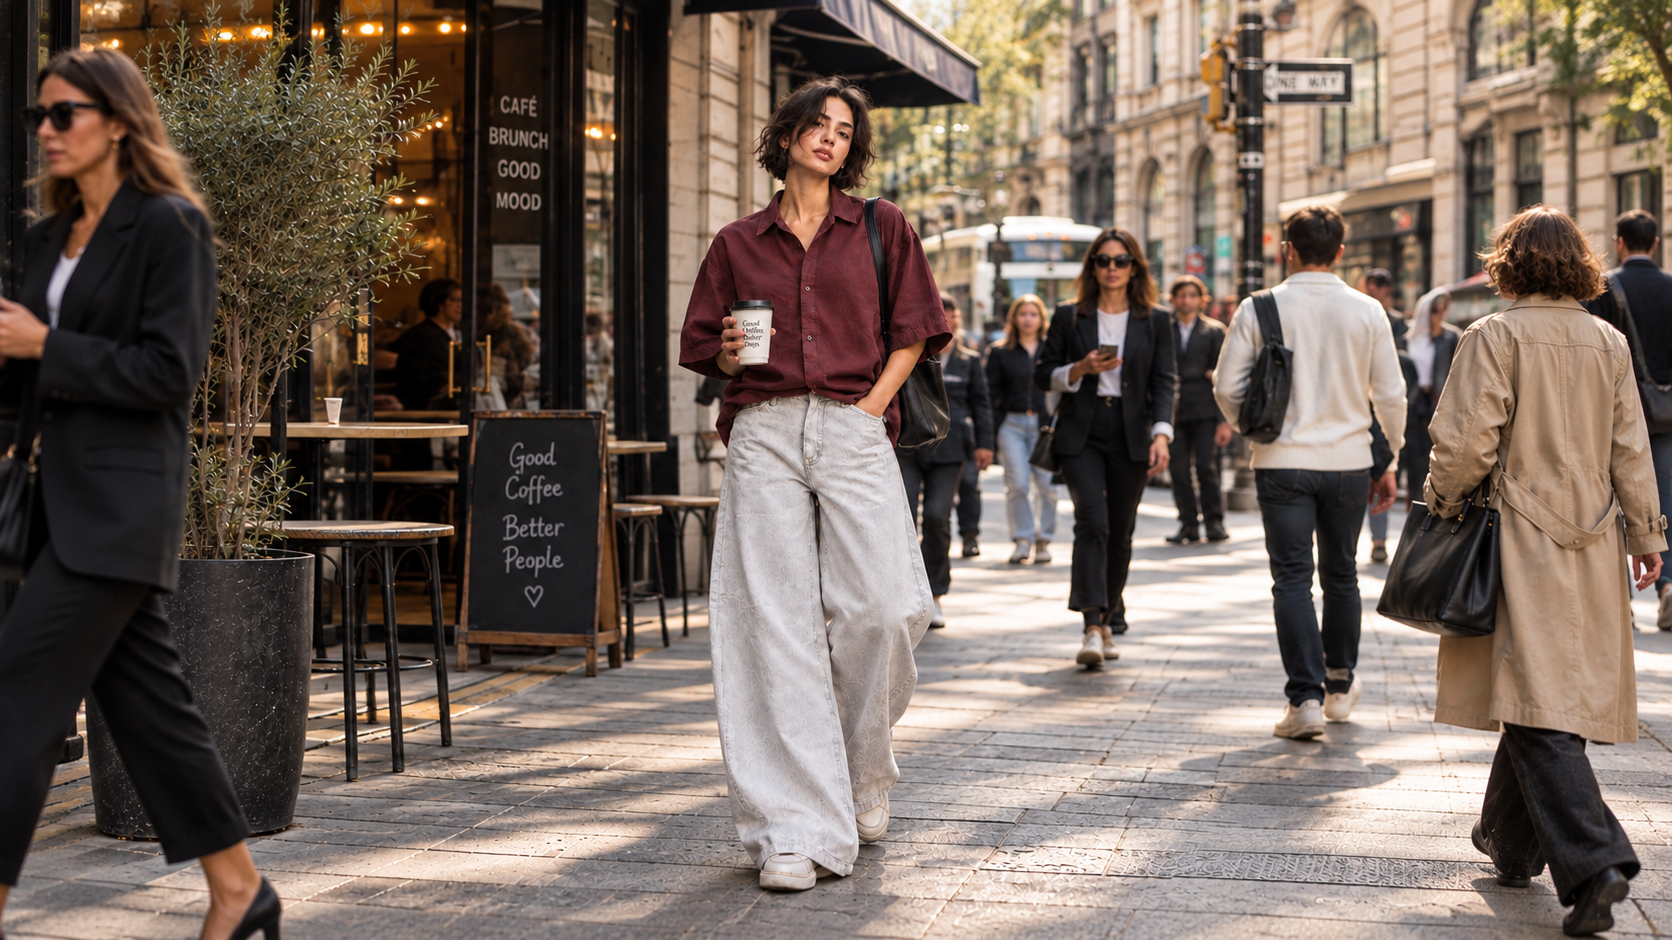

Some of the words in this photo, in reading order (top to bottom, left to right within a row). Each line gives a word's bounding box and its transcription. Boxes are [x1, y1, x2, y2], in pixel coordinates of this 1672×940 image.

[1308, 75, 1339, 89] WAY
[500, 94, 538, 118] CAFÉ
[488, 126, 549, 150] BRUNCH
[497, 159, 541, 180] GOOD
[496, 191, 542, 211] MOOD
[509, 441, 557, 475] Good
[505, 474, 564, 505] Coffee
[502, 513, 565, 541] Better
[502, 545, 564, 578] People
